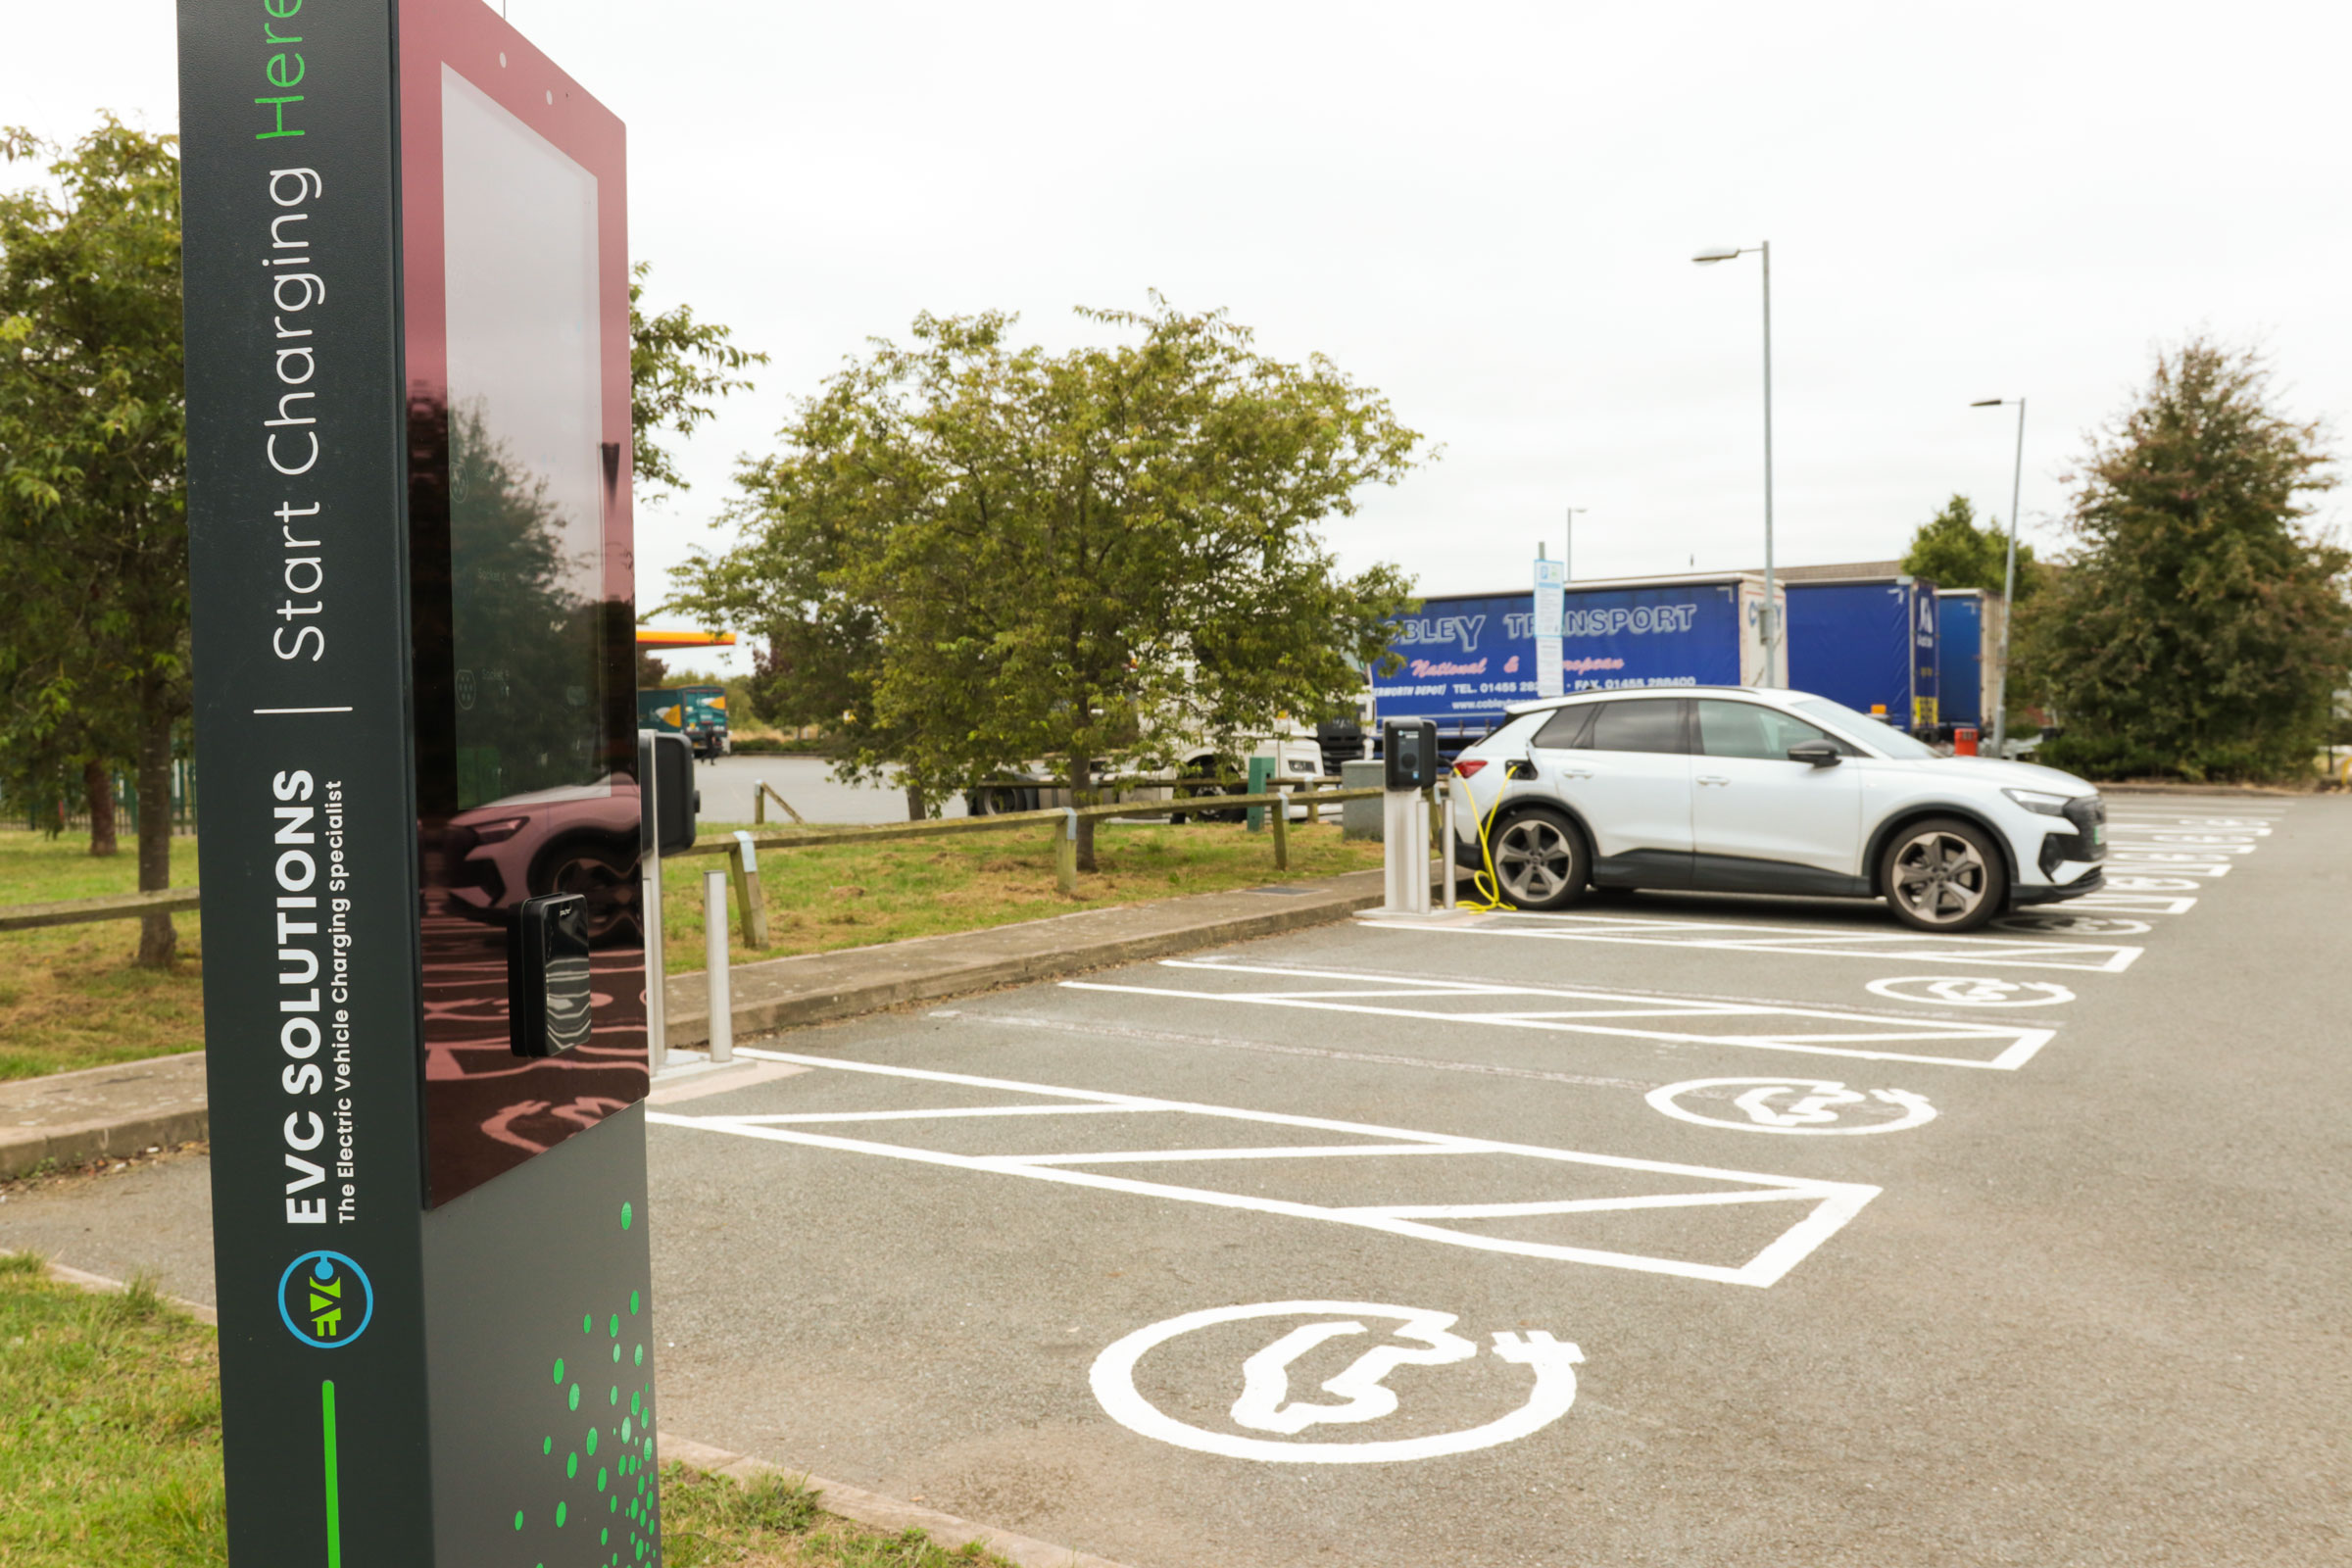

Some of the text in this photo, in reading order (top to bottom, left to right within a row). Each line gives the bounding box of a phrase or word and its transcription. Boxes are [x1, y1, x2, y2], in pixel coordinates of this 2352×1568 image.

[262, 167, 325, 475] Charging
[272, 501, 325, 662] Start
[1381, 604, 1696, 653] BLEY TNSPORT
[1409, 657, 1488, 678] National
[1502, 655, 1520, 673] &
[1452, 683, 1478, 694] TEL.
[1480, 681, 1518, 694] 01455
[1604, 678, 1644, 691] 01455
[272, 769, 326, 1224] EVC SOLUTIONS
[324, 780, 356, 1224] The Electric Vehicle Charging Specialist
